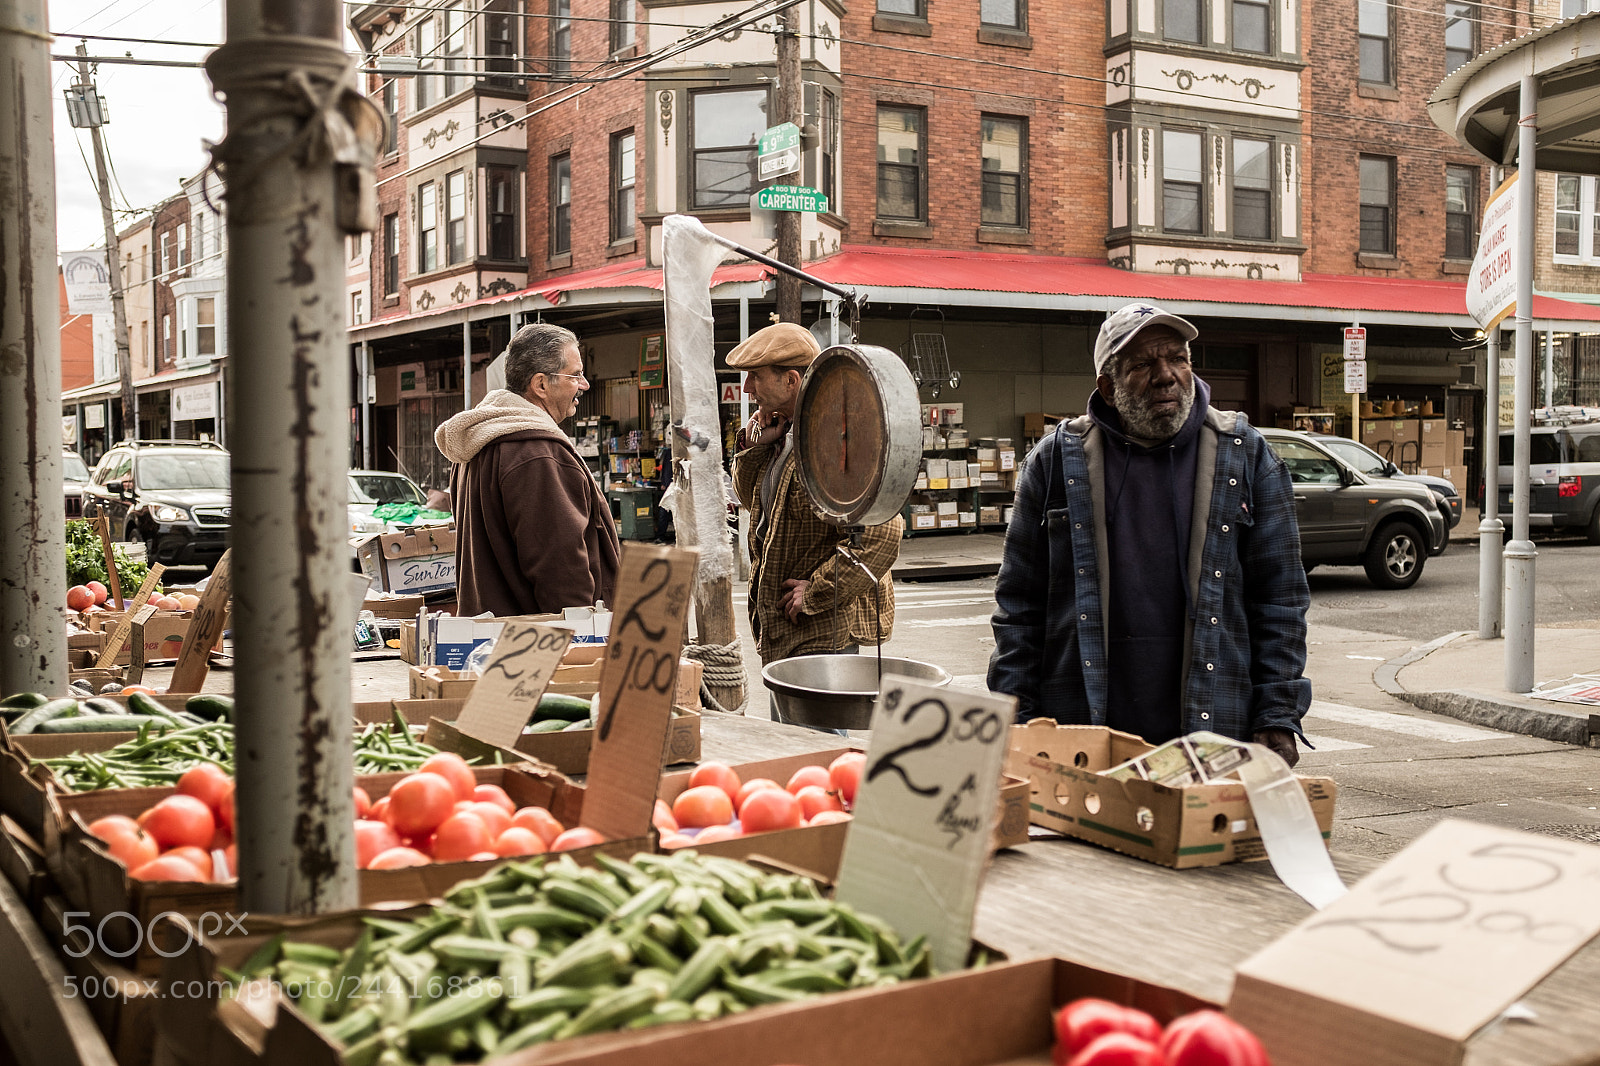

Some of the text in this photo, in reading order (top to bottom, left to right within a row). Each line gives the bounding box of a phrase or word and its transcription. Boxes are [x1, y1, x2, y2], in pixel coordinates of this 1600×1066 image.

[788, 134, 798, 147] ST
[789, 186, 798, 194] W
[760, 193, 827, 212] CARPENTER ST
[1480, 263, 1492, 294] STORE
[1497, 247, 1512, 279] OPEN
[403, 561, 456, 585] SunTer
[617, 558, 672, 642] 2
